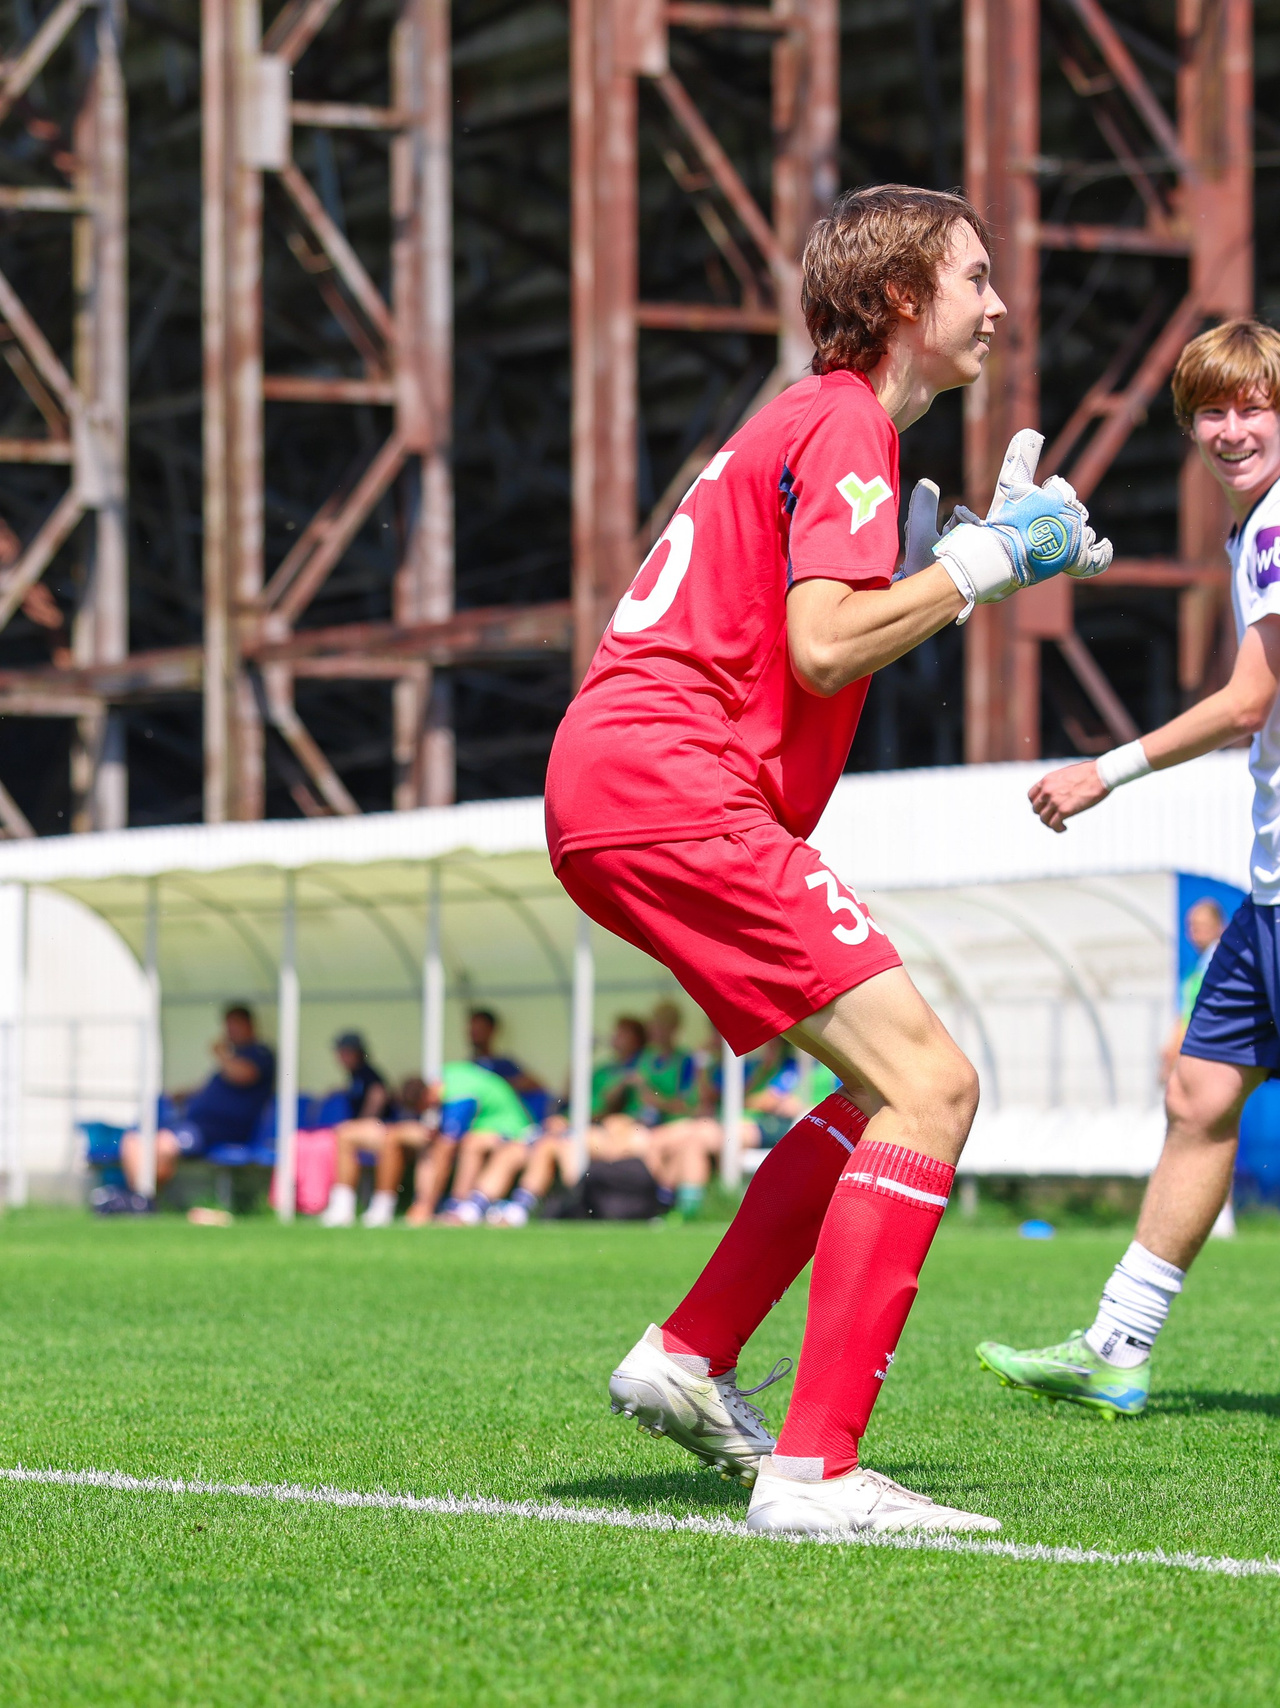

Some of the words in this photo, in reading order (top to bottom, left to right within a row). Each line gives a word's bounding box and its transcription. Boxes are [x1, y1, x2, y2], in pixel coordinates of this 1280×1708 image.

[610, 451, 735, 632] 5
[804, 869, 884, 945] 3
[838, 1172, 874, 1184] LME
